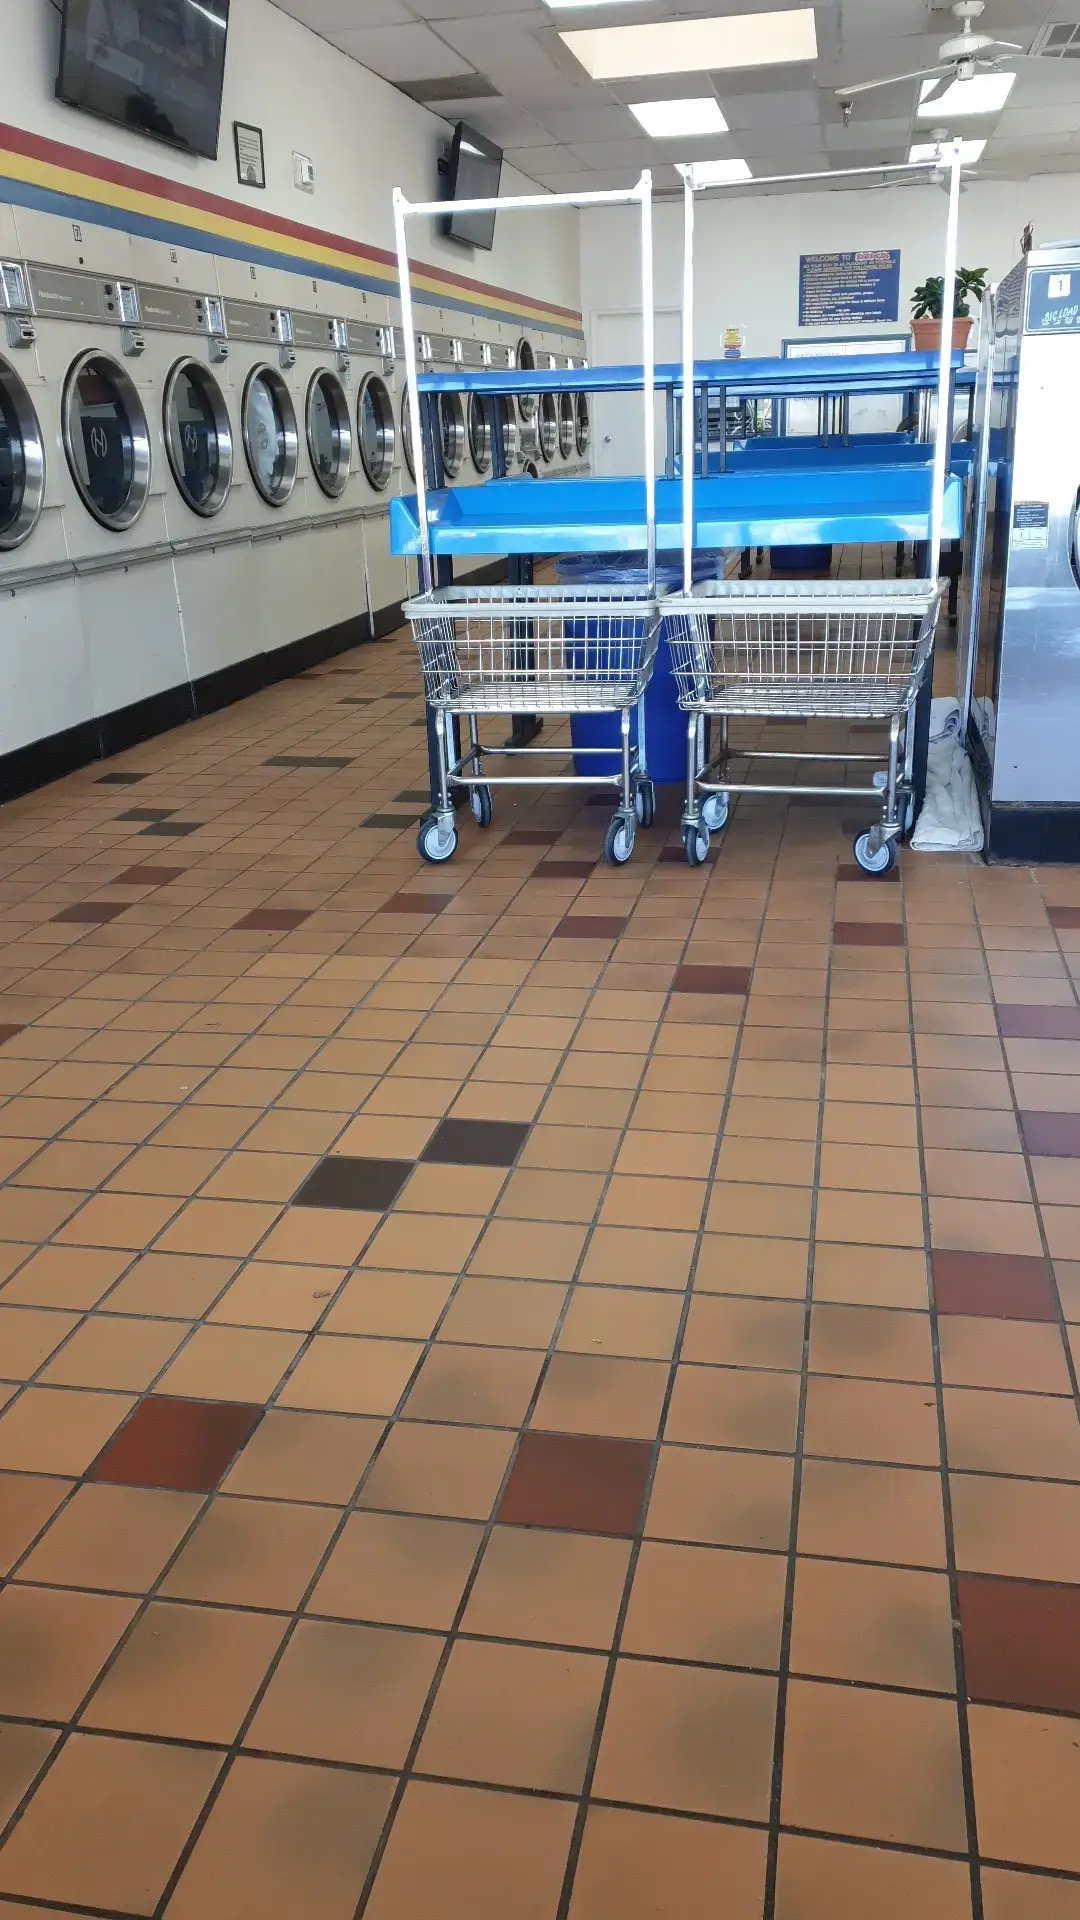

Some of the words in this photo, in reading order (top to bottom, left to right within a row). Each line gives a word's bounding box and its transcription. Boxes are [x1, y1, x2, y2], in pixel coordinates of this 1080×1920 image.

[1058, 279, 1063, 291] 1
[1045, 311, 1058, 322] BIG
[1058, 304, 1079, 318] LOAD
